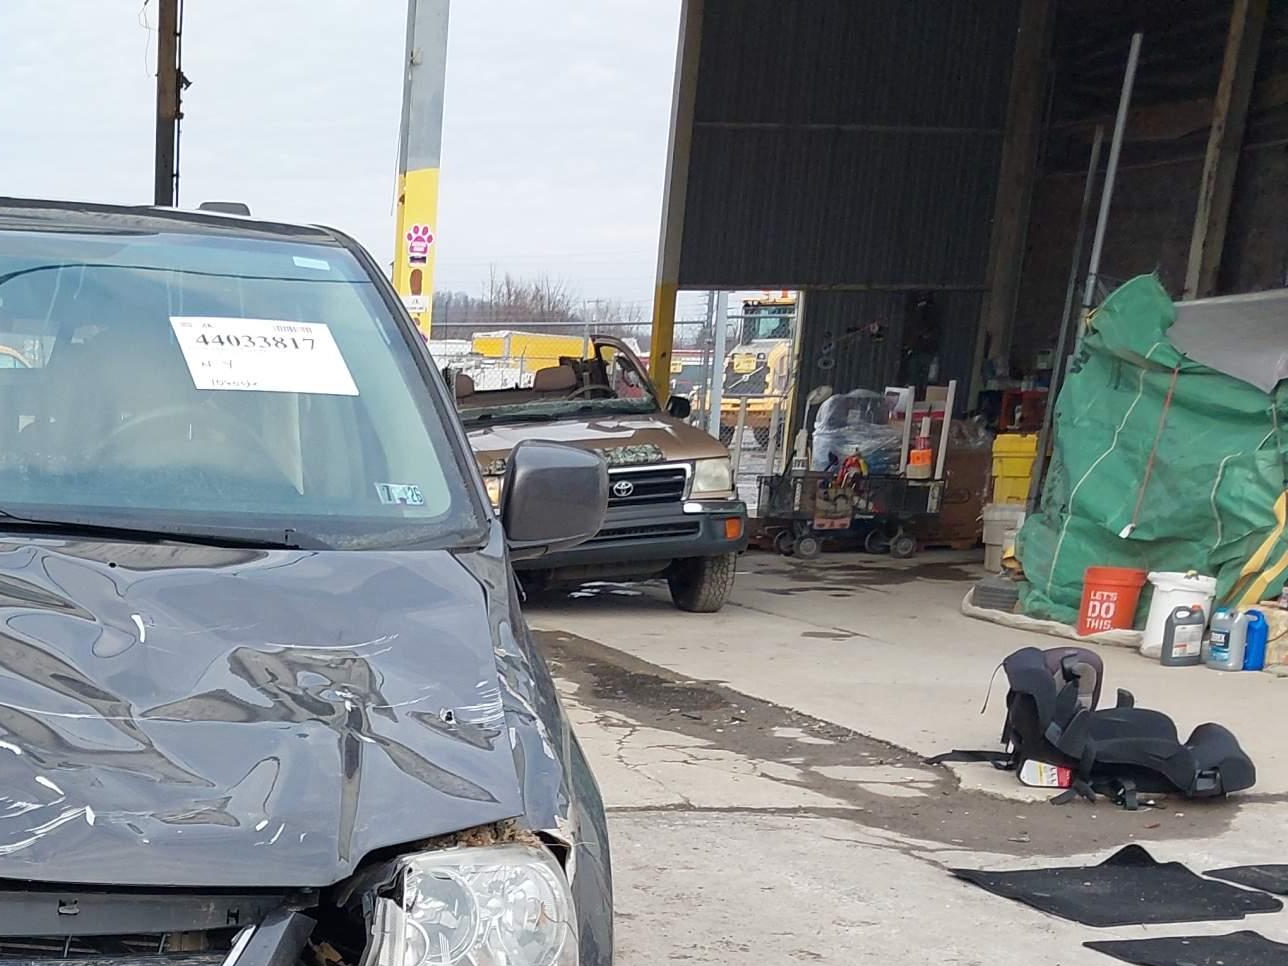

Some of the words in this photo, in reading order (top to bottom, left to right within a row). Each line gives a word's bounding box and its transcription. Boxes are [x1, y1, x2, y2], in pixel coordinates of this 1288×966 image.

[195, 332, 316, 351] 44033817
[1090, 590, 1118, 602] LET'S
[1087, 600, 1116, 619] DO
